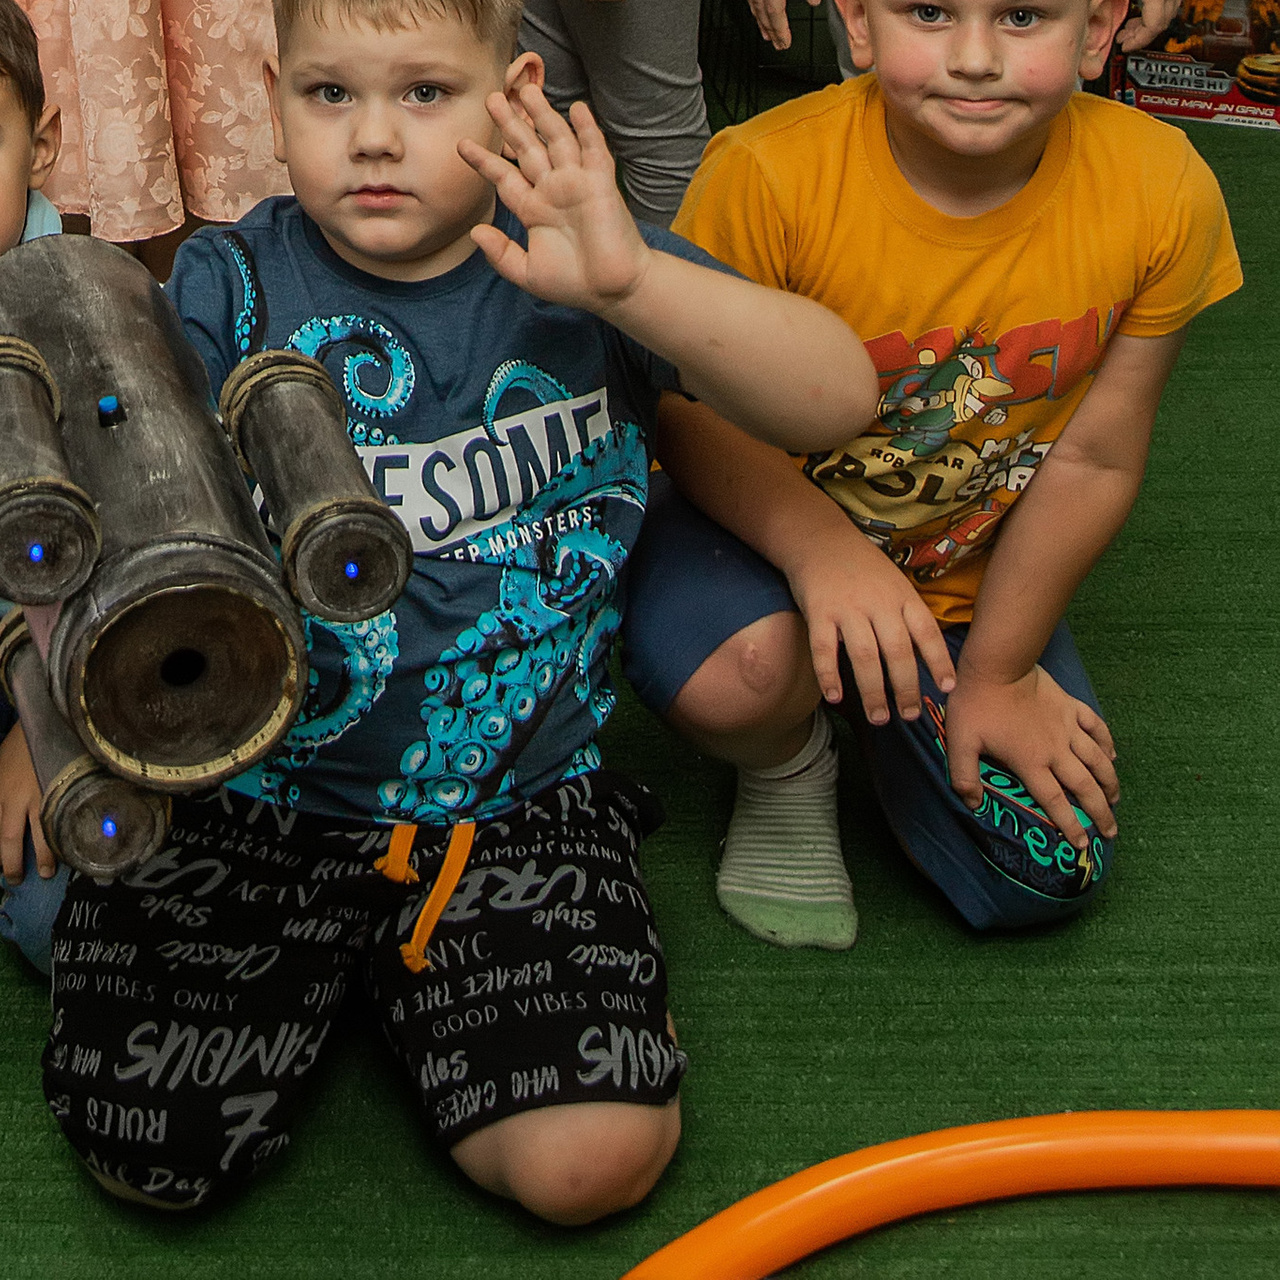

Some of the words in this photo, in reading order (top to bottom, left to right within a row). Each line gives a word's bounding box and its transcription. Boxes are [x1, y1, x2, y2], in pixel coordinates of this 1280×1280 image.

[1130, 58, 1205, 77] TAIKONG
[1147, 74, 1224, 91] ZHANSHI
[1140, 94, 1180, 107] DONG
[1180, 100, 1213, 110] MAN
[1235, 104, 1276, 118] GANG
[487, 505, 594, 558] MONSTERS
[560, 840, 620, 863] BRAND
[67, 900, 109, 930] NYC
[531, 900, 598, 933] Style
[424, 930, 493, 972] NYC
[564, 943, 658, 987] Classic
[95, 974, 158, 1003] VIBES
[173, 987, 240, 1013] ONLY
[432, 1003, 500, 1039] GOOD
[514, 991, 589, 1018] VIBES
[600, 990, 648, 1016] ONLY
[113, 1019, 331, 1092] FAMOUS
